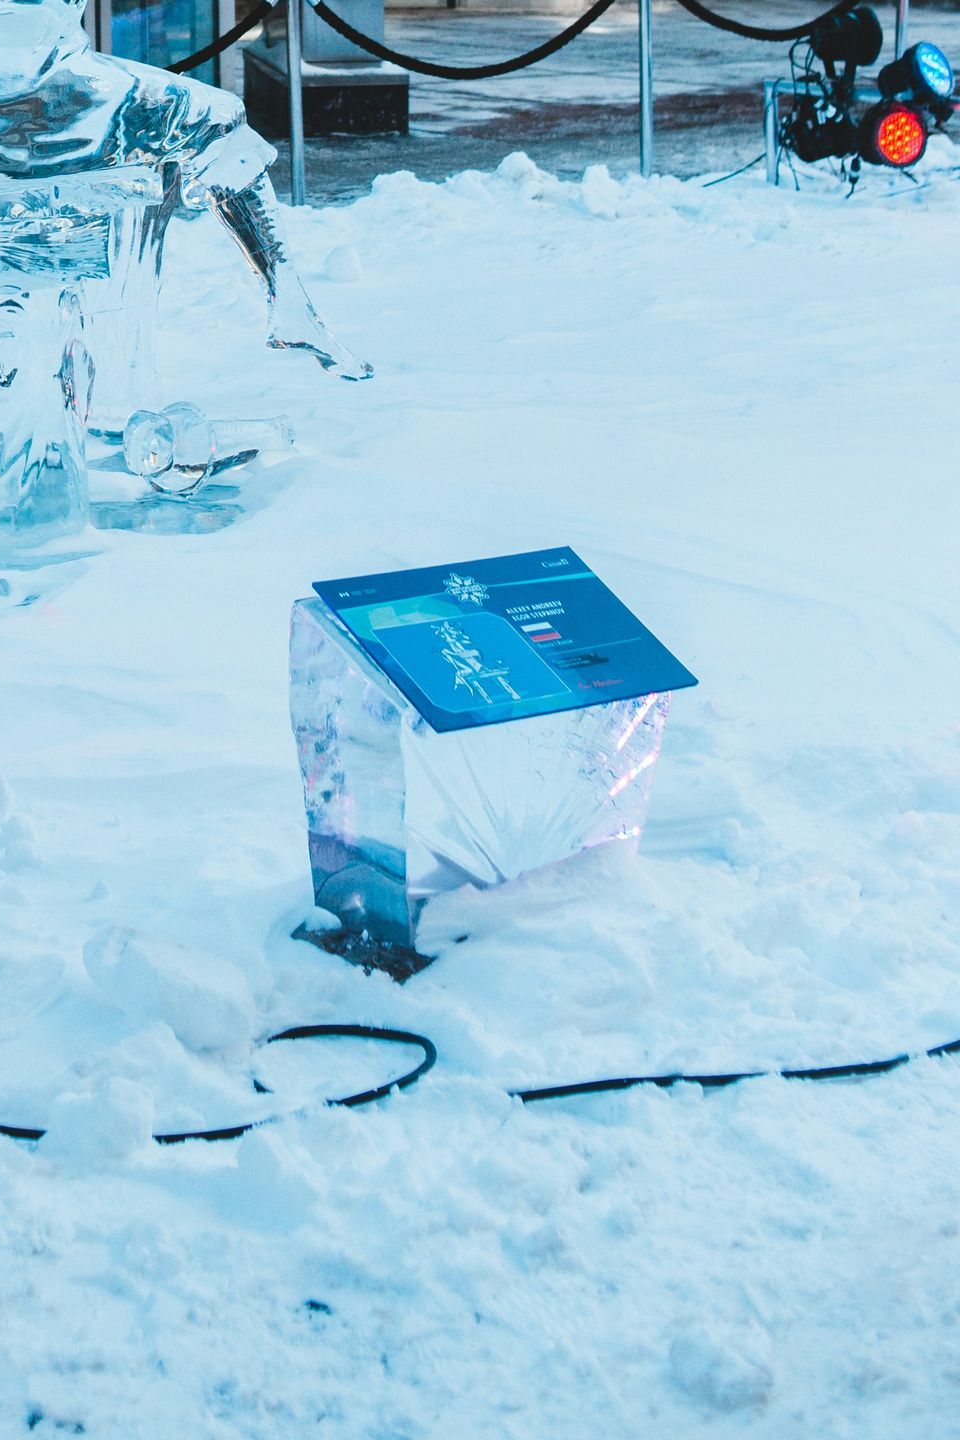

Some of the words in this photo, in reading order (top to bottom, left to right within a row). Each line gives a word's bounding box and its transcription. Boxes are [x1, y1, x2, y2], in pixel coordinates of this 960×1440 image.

[506, 606, 530, 614] ALEXEY
[531, 601, 561, 610] ANDREEV
[512, 613, 530, 621] EGOR
[530, 607, 565, 618] STEPANOV
